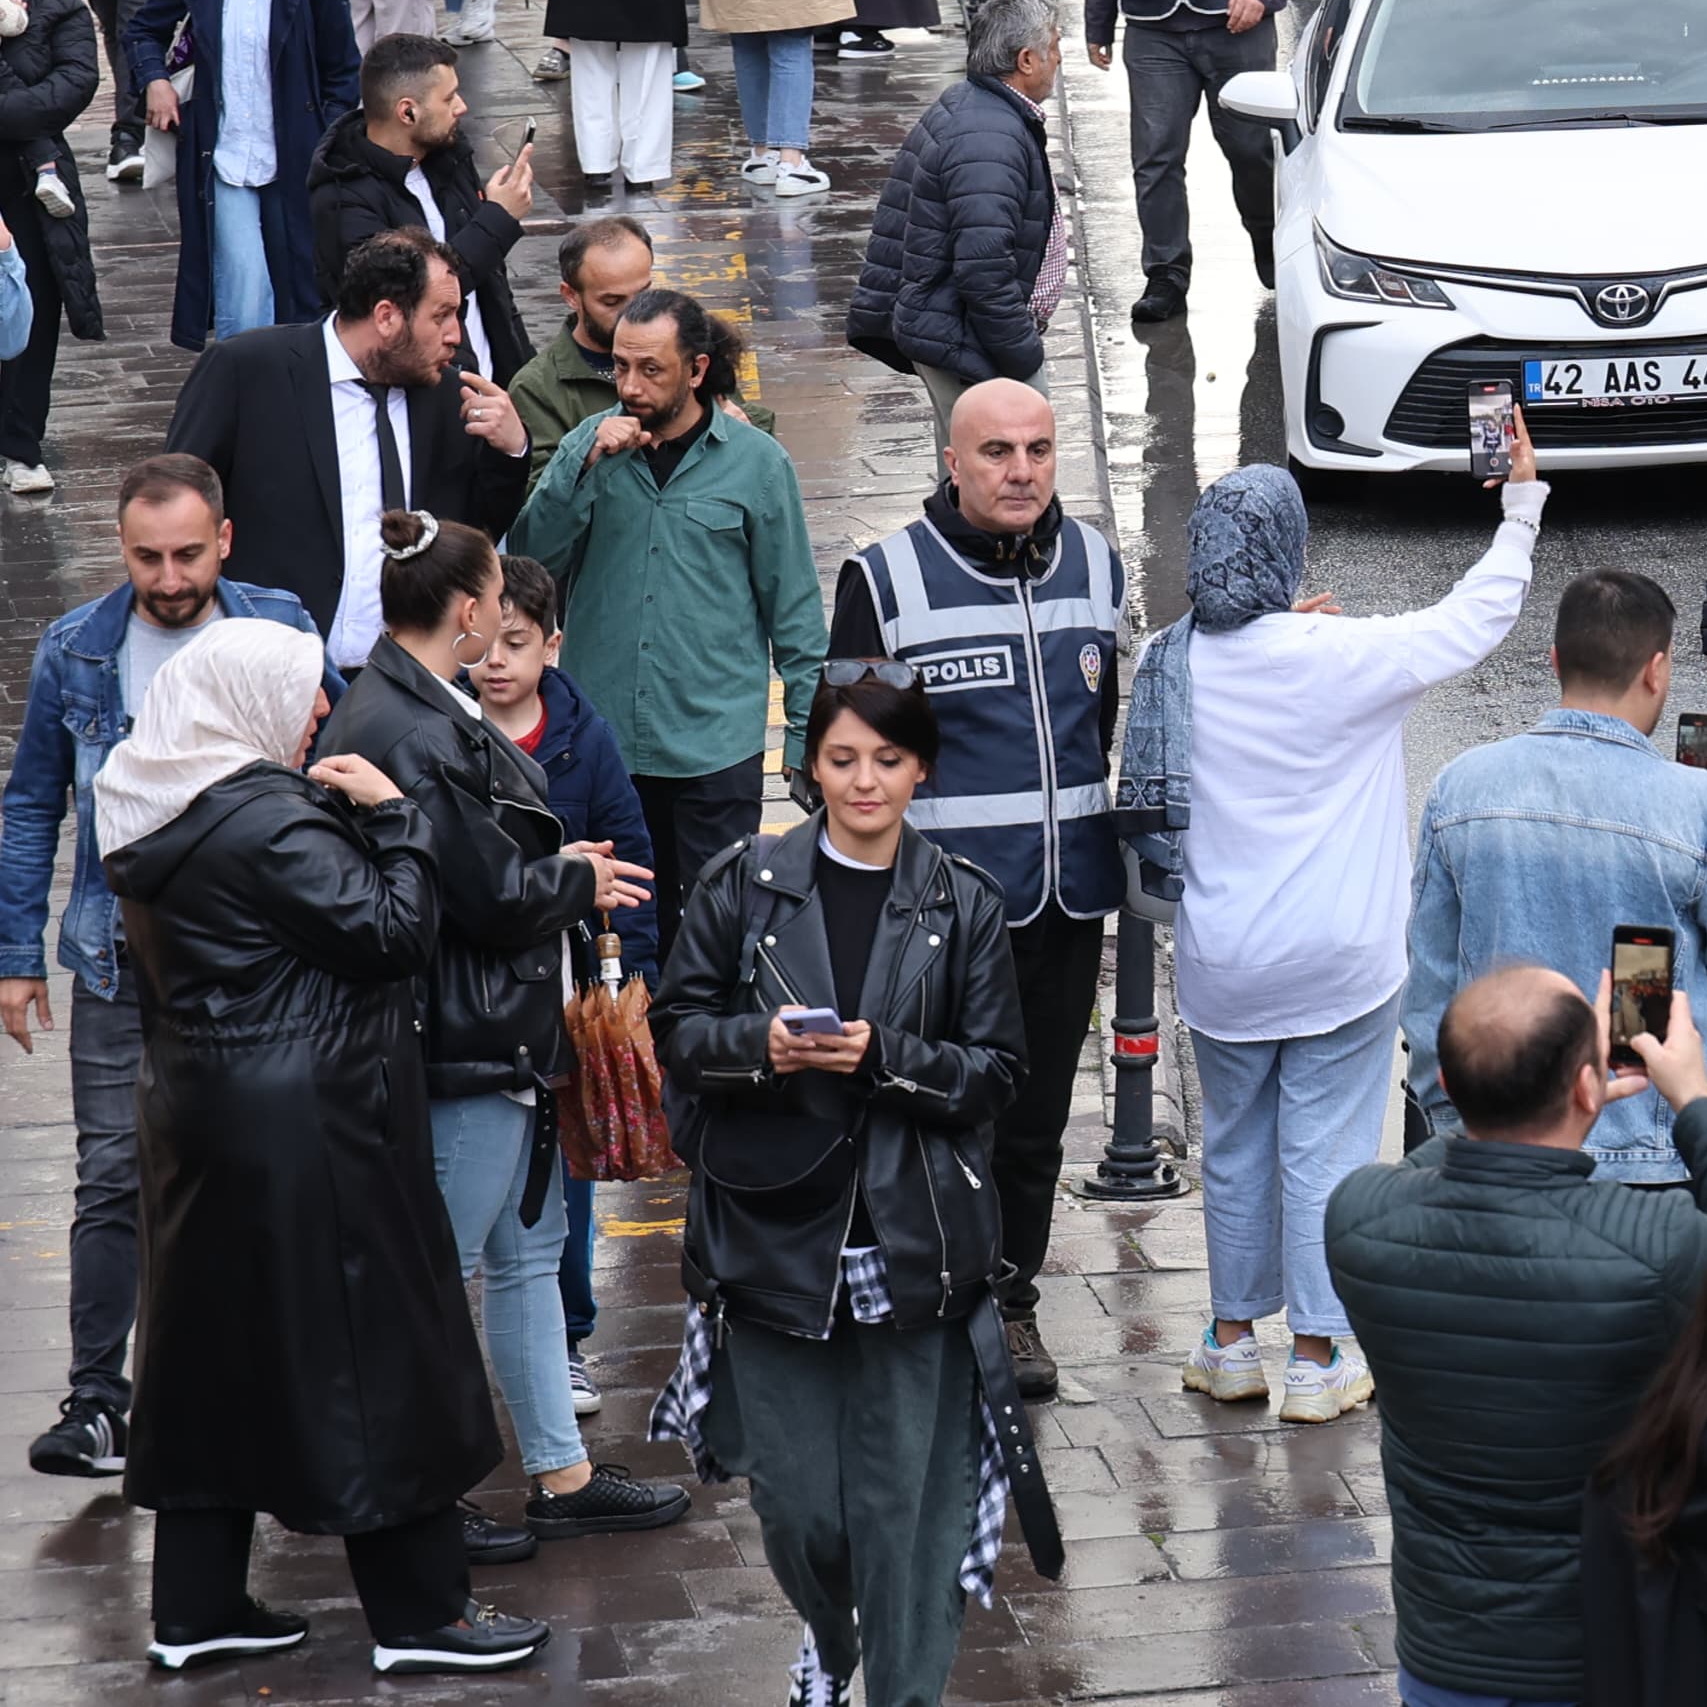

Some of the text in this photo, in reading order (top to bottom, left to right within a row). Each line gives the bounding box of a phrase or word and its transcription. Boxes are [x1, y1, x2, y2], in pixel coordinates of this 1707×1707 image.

[1528, 383, 1542, 393] TR
[1544, 363, 1584, 396] 42
[1604, 360, 1662, 394] AAS
[1630, 394, 1671, 406] OTO
